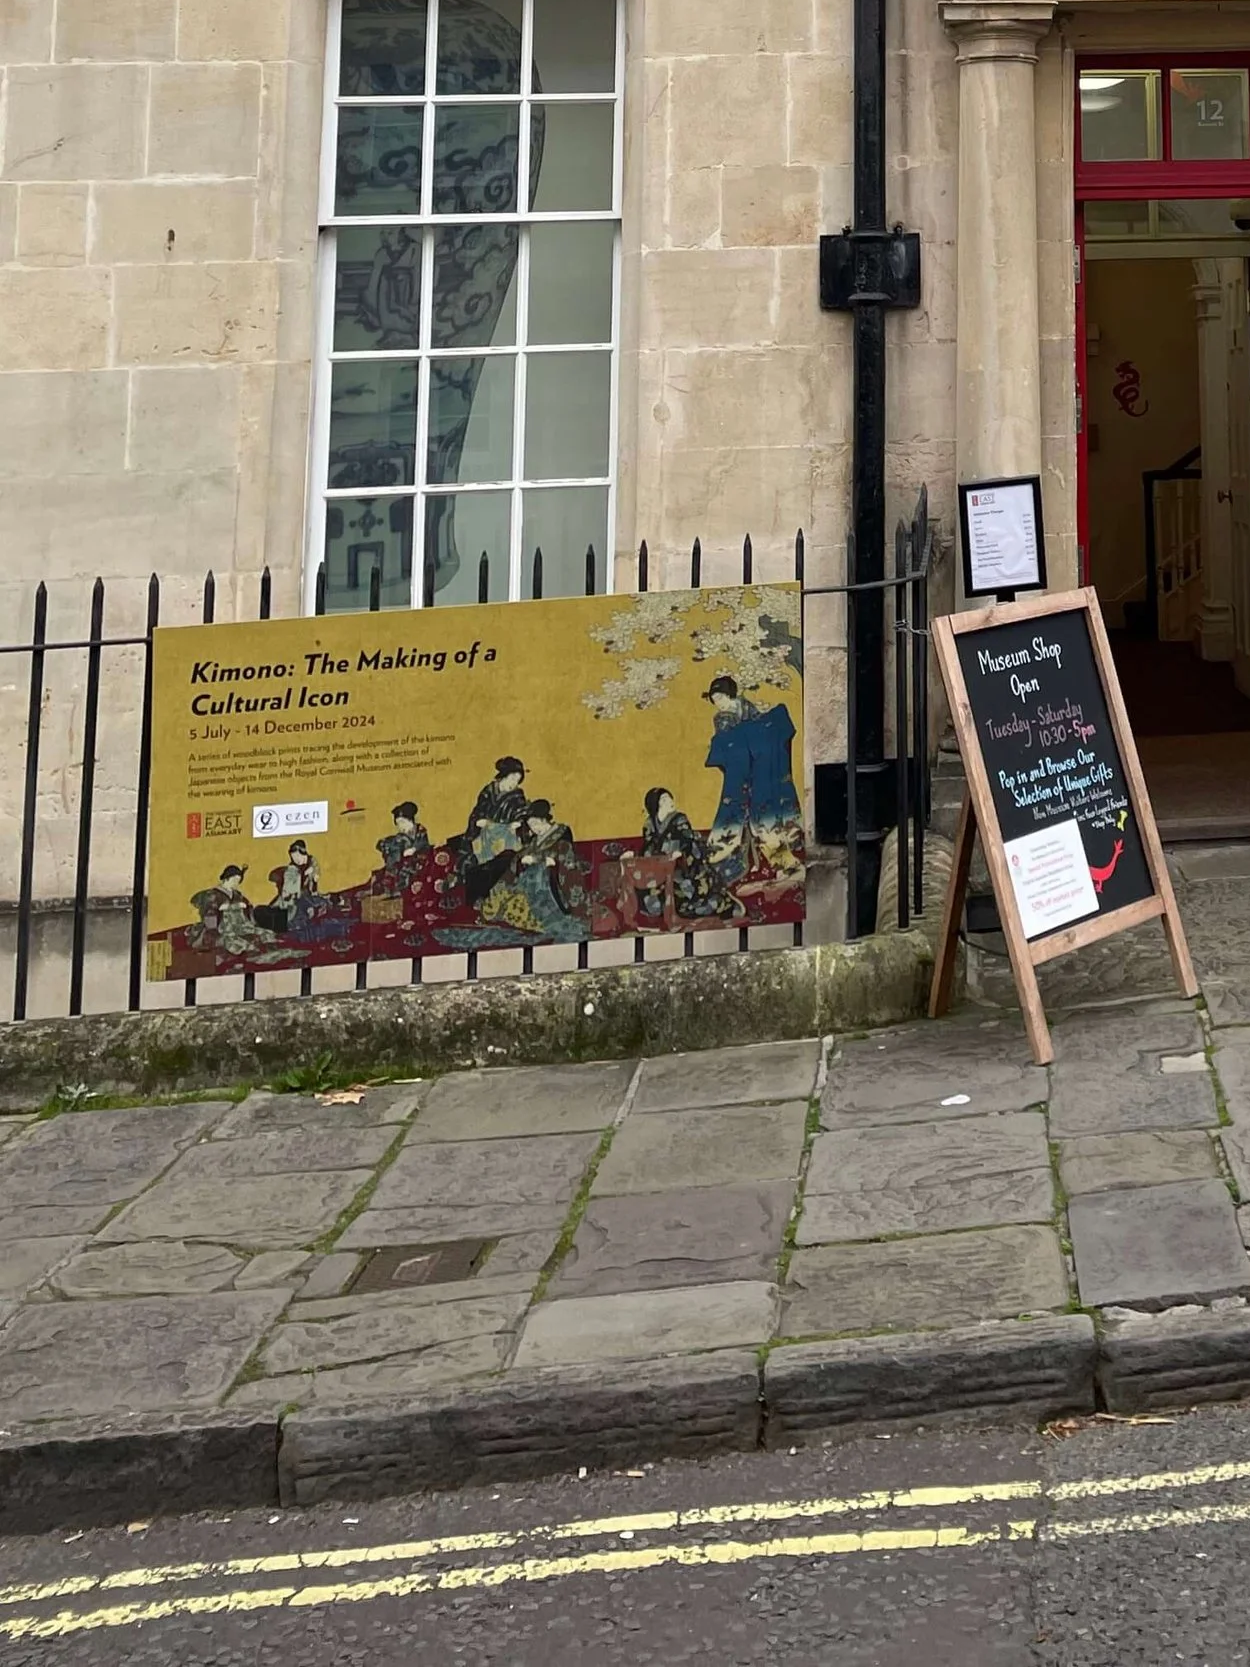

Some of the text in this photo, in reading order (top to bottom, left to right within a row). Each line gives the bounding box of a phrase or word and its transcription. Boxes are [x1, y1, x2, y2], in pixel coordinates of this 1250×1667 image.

[1196, 100, 1224, 121] 12
[191, 642, 497, 684] Kimono: The Making of a
[977, 636, 1062, 675] Museum Shop
[191, 687, 350, 717] Cultural Icon
[1010, 674, 1040, 703] Open
[190, 728, 197, 740] 5
[202, 723, 231, 742] July
[245, 723, 260, 737] 14
[264, 717, 338, 736] December
[342, 715, 376, 728] 2024
[985, 712, 1031, 747] Tuesday
[1037, 698, 1082, 726] Saturday
[188, 753, 196, 762] A
[222, 749, 231, 759] of
[401, 735, 410, 745] of
[279, 757, 298, 769] high
[381, 748, 419, 759] collection
[421, 745, 430, 756] of
[295, 767, 317, 778] Royal
[998, 748, 1096, 794] Pop in and Browse Our
[236, 784, 245, 795] of
[1014, 762, 1114, 808] Selection of Unique Gifts
[205, 815, 242, 830] EAST
[286, 810, 320, 822] ezen
